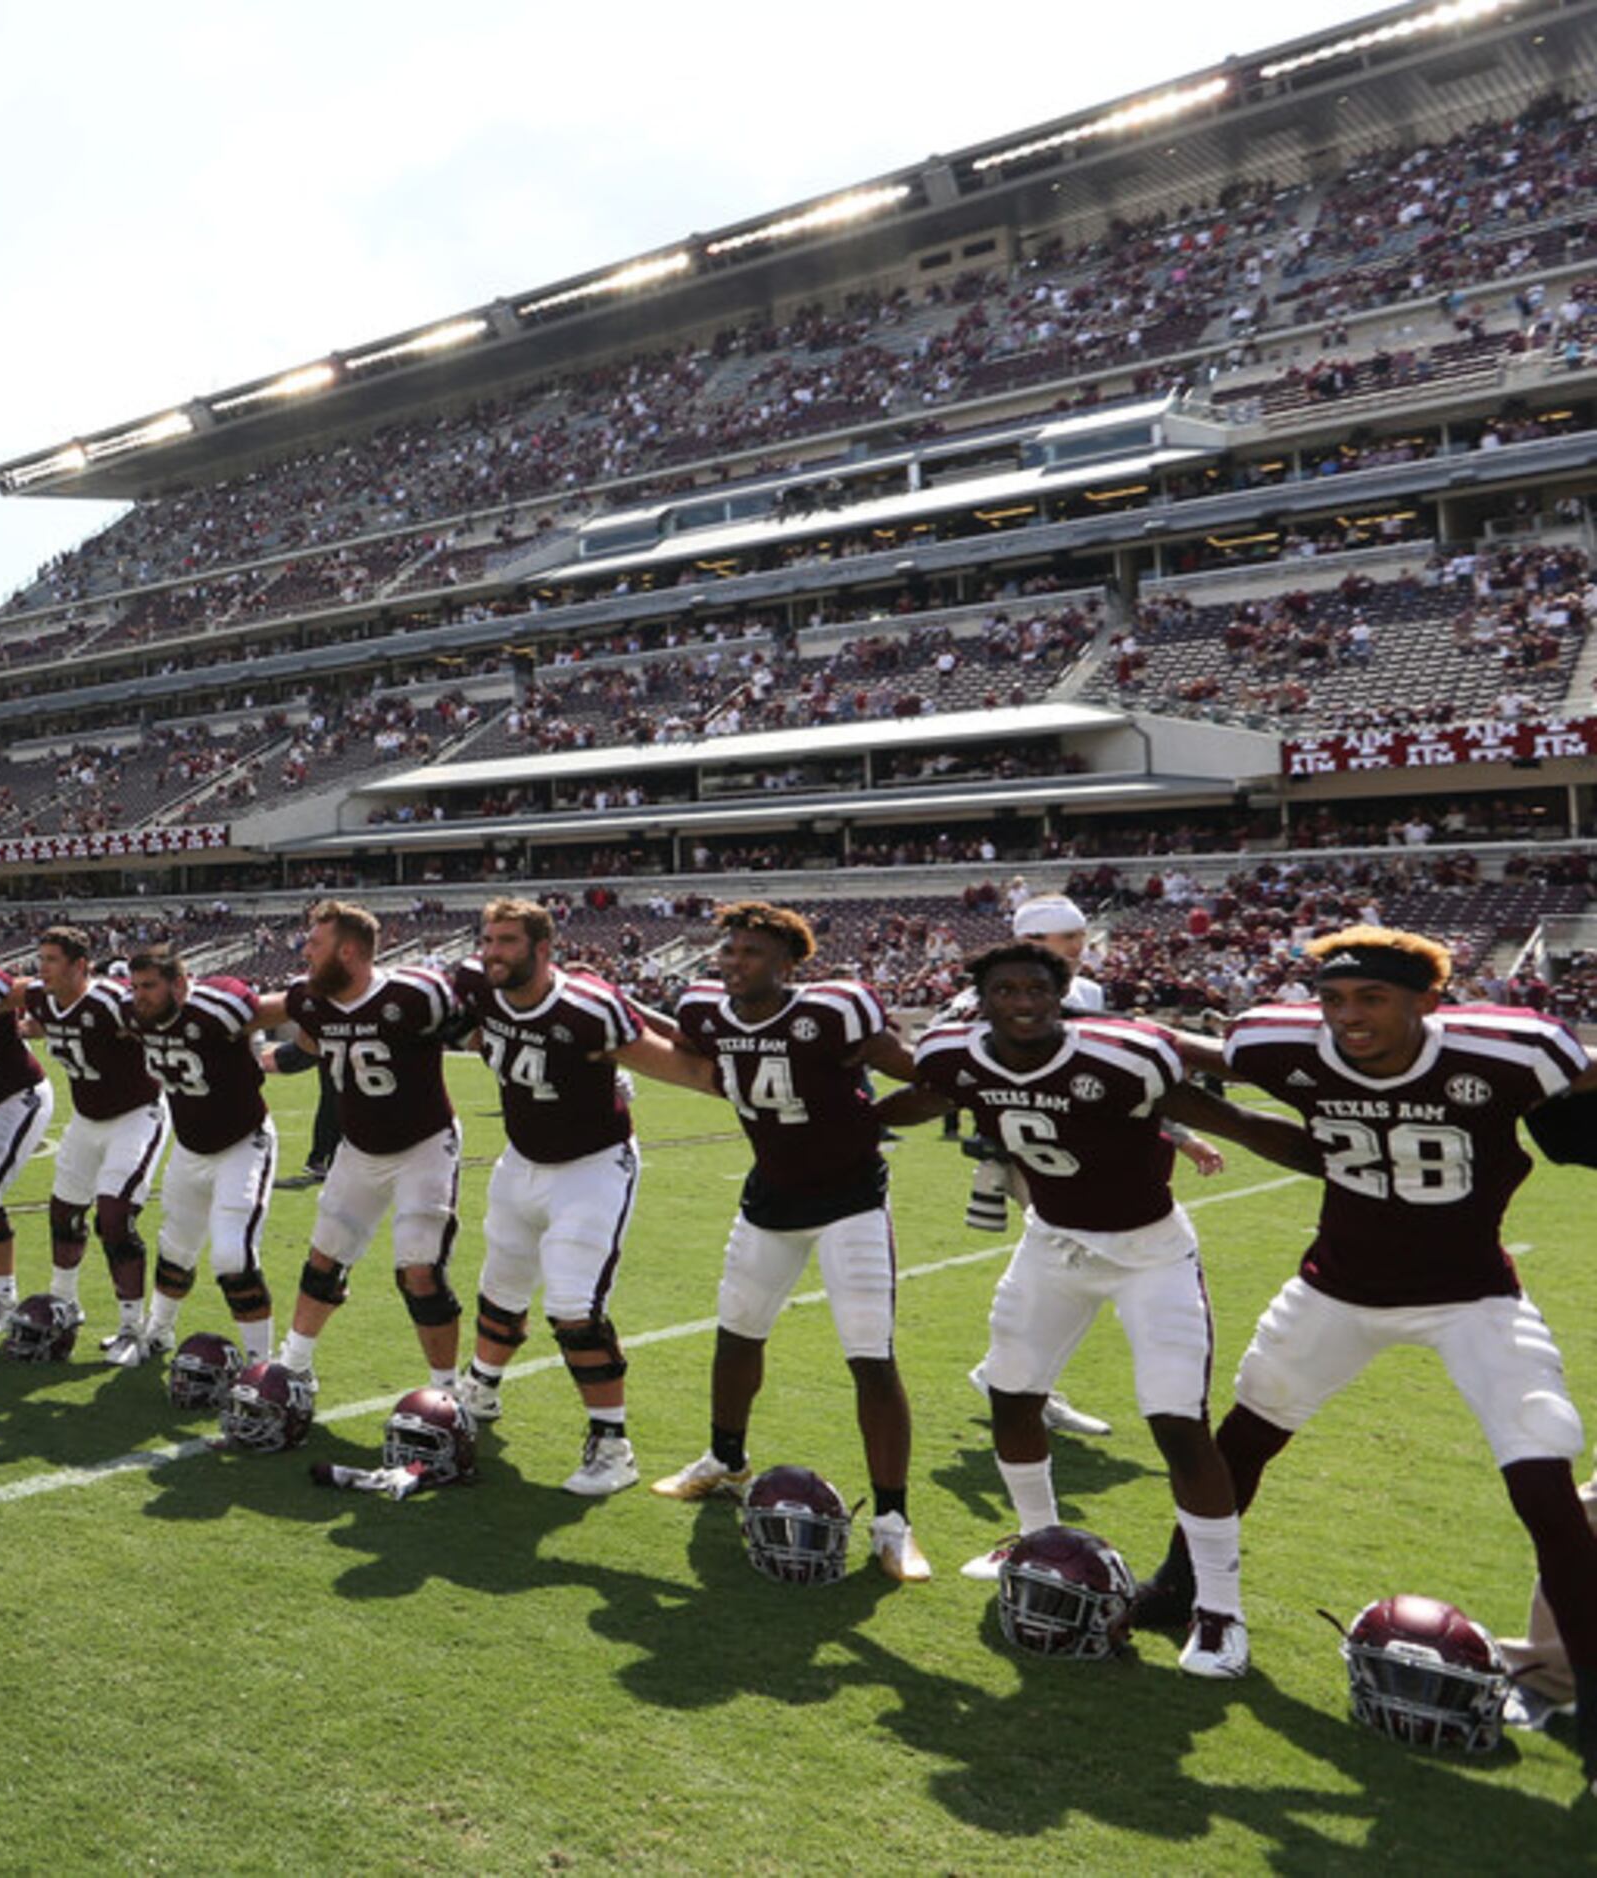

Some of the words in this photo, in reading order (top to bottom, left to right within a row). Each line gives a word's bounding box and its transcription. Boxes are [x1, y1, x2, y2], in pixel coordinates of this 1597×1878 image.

[318, 1039, 398, 1096] 76
[481, 1028, 559, 1100] 74
[716, 1038, 755, 1052] TEXAS
[717, 1054, 809, 1124] 14
[978, 1089, 1030, 1106] TEXAS
[1316, 1100, 1390, 1118] TEXAS
[1449, 1077, 1489, 1102] SEC
[998, 1109, 1081, 1177] 6
[1309, 1115, 1474, 1205] 28
